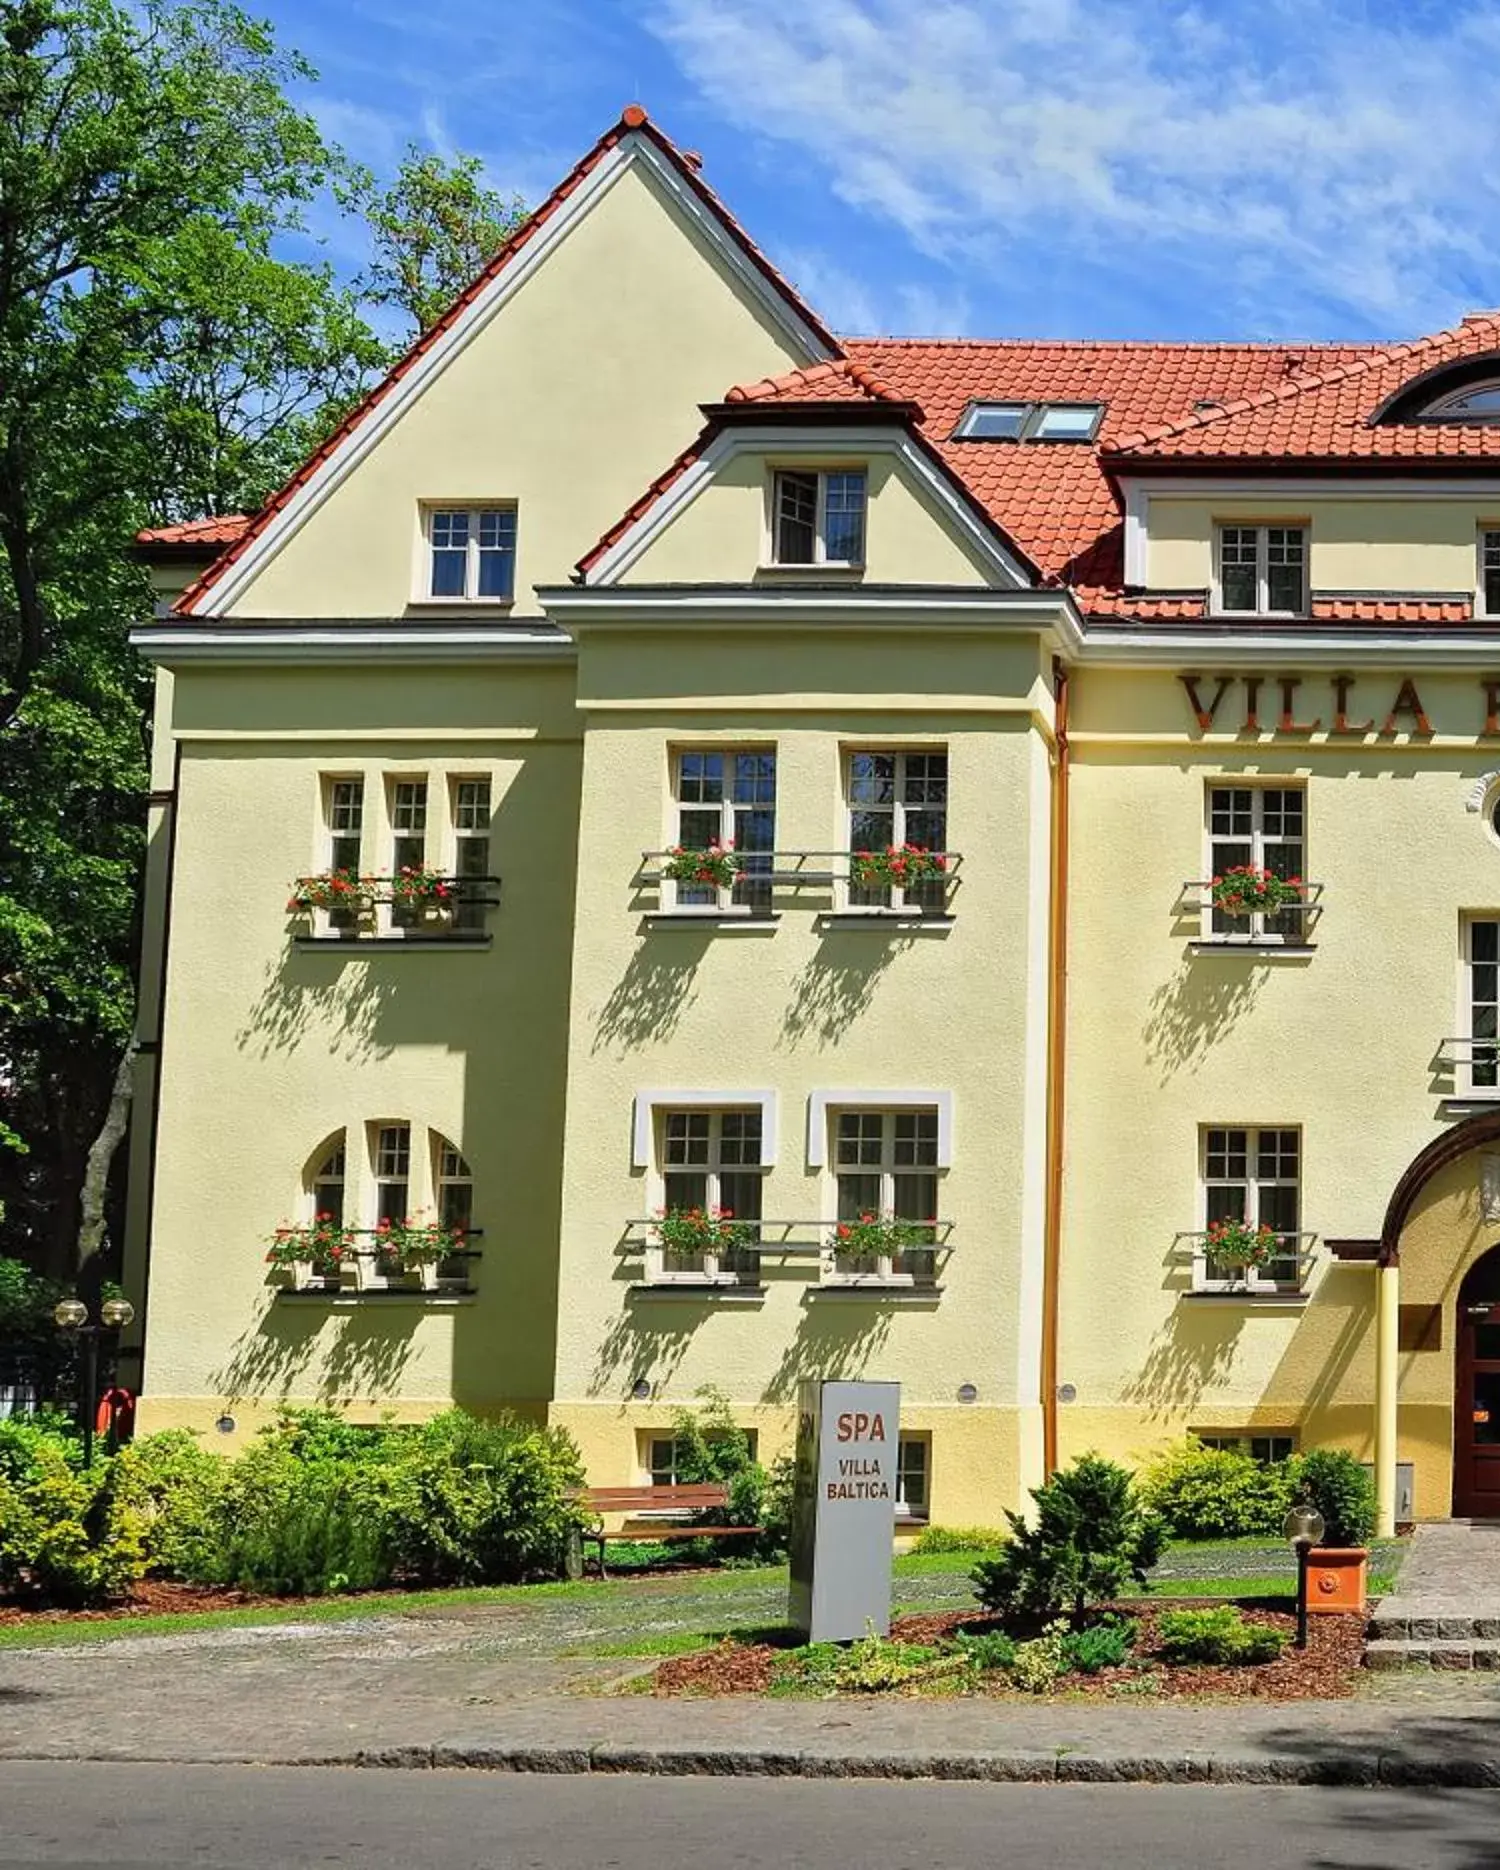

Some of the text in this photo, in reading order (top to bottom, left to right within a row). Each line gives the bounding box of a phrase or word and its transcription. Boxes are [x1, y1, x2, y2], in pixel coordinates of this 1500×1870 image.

[1178, 674, 1434, 736] VILLA
[837, 1413, 885, 1442] SPA
[839, 1459, 881, 1476] VILLA
[827, 1482, 889, 1500] BALTICA
